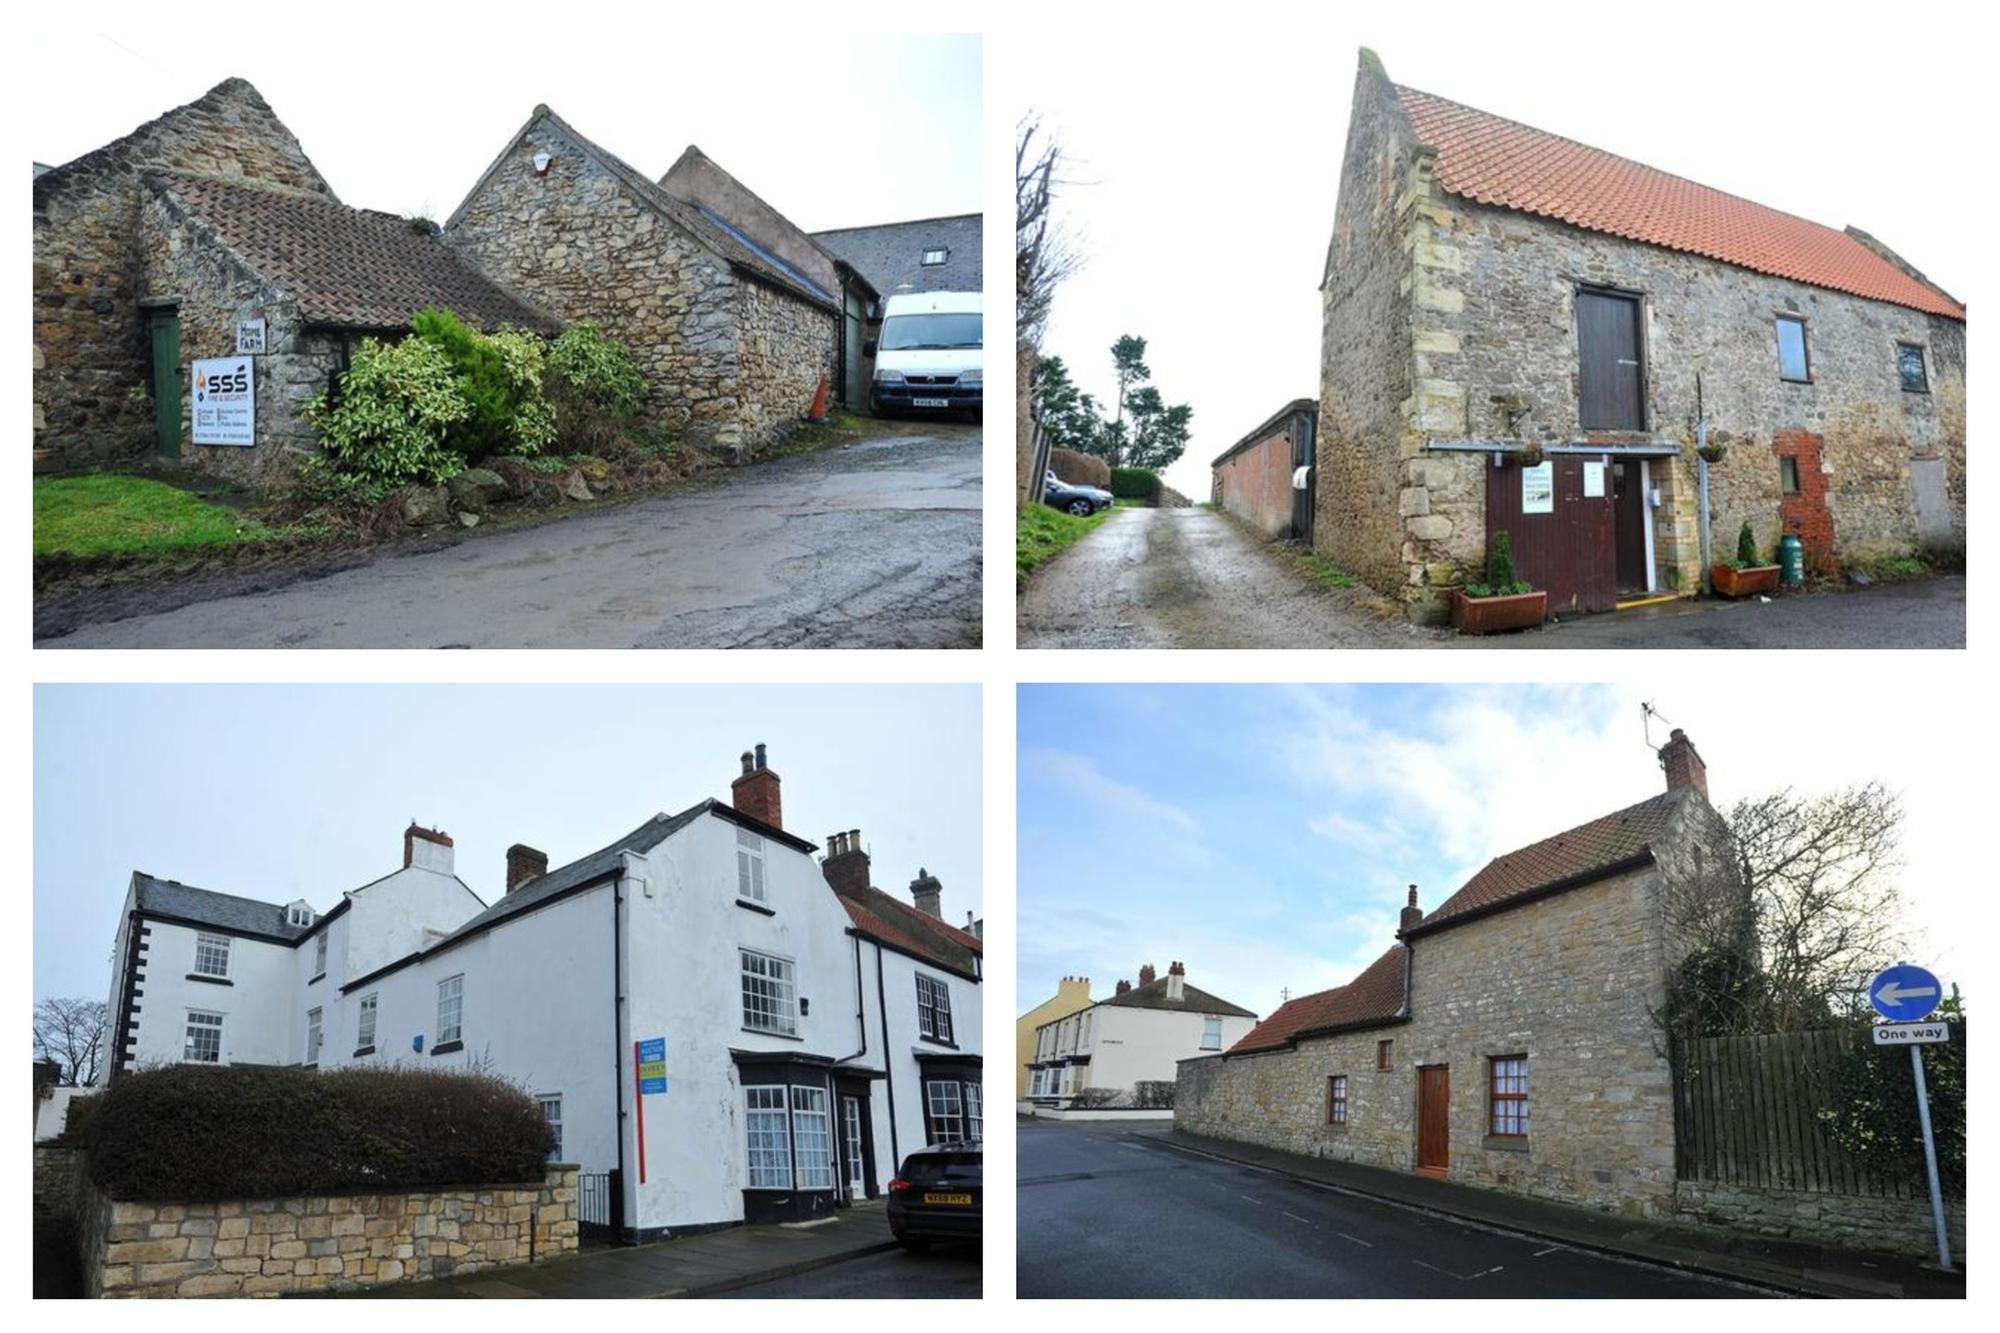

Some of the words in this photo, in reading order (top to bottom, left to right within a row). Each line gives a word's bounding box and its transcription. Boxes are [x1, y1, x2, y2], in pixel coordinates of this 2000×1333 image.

[240, 337, 262, 350] FARM
[1879, 1029, 1908, 1040] One
[1912, 1024, 1942, 1039] way
